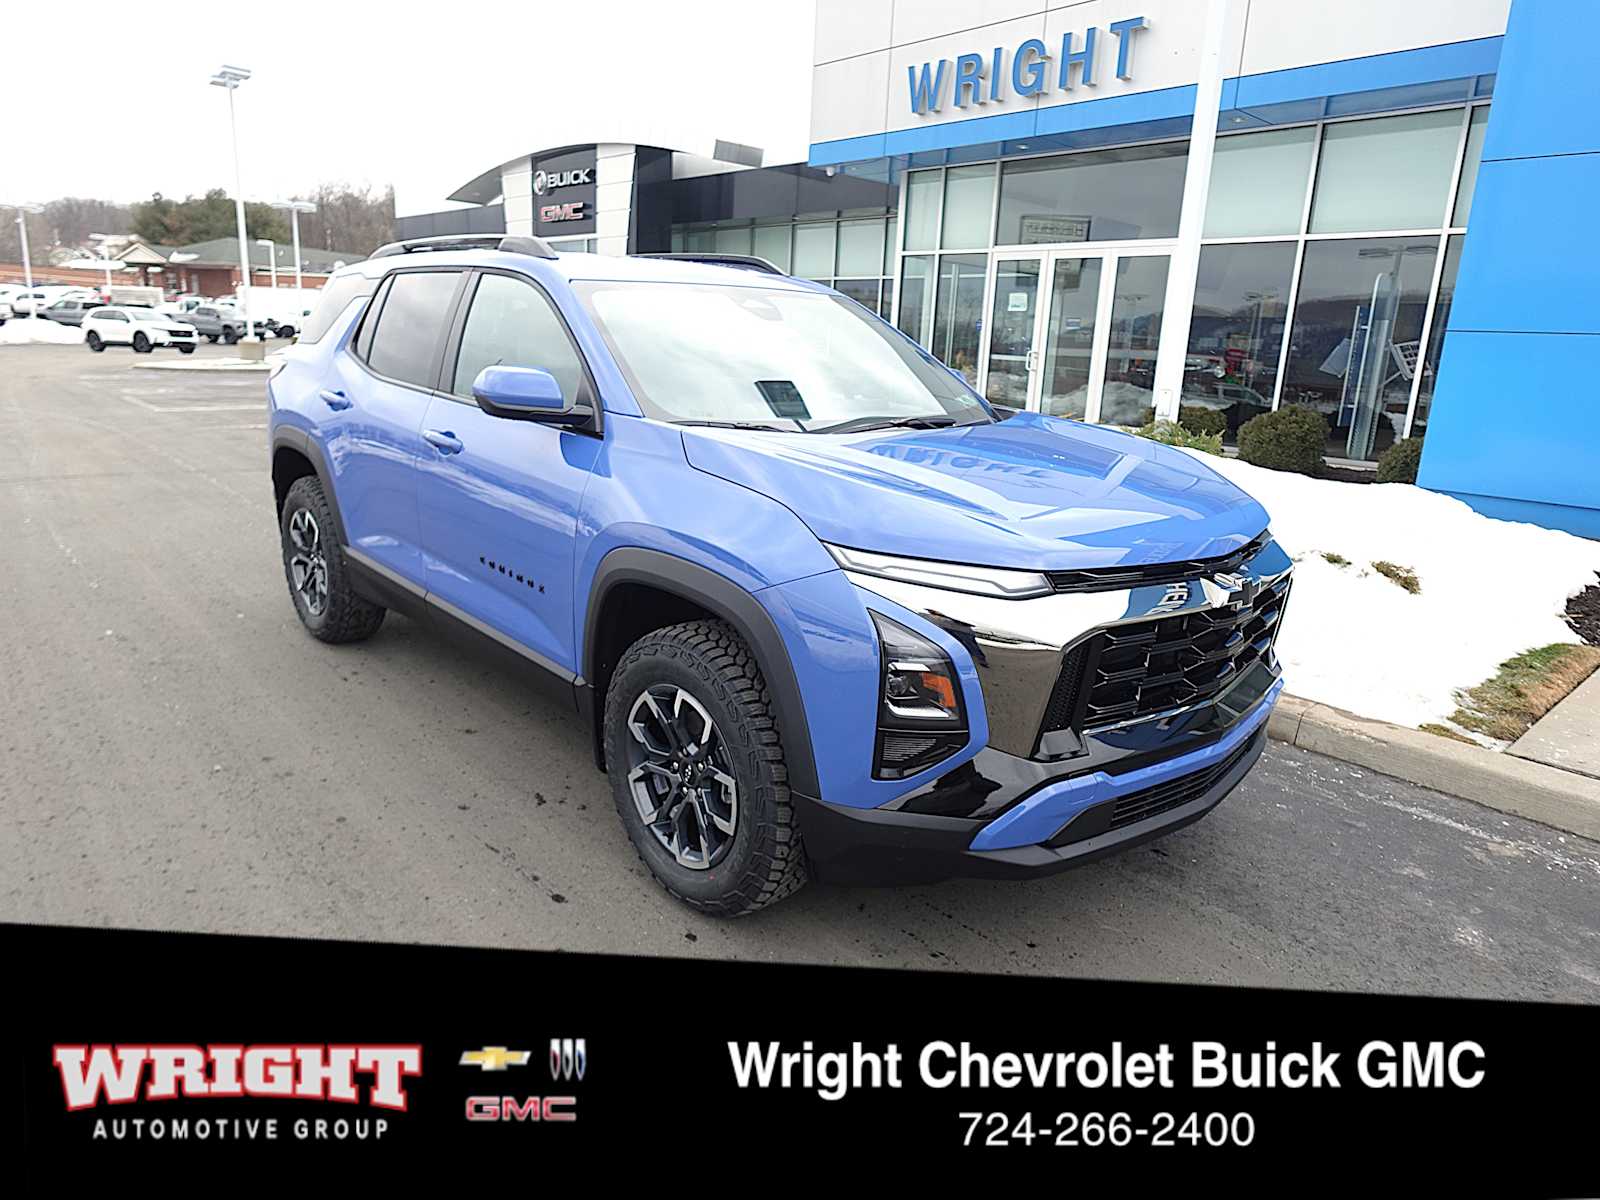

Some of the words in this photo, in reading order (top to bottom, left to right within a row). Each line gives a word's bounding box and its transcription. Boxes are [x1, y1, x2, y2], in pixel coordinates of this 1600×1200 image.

[907, 16, 1149, 115] WRIGHT
[547, 168, 592, 188] BUICK
[540, 201, 584, 222] GMC
